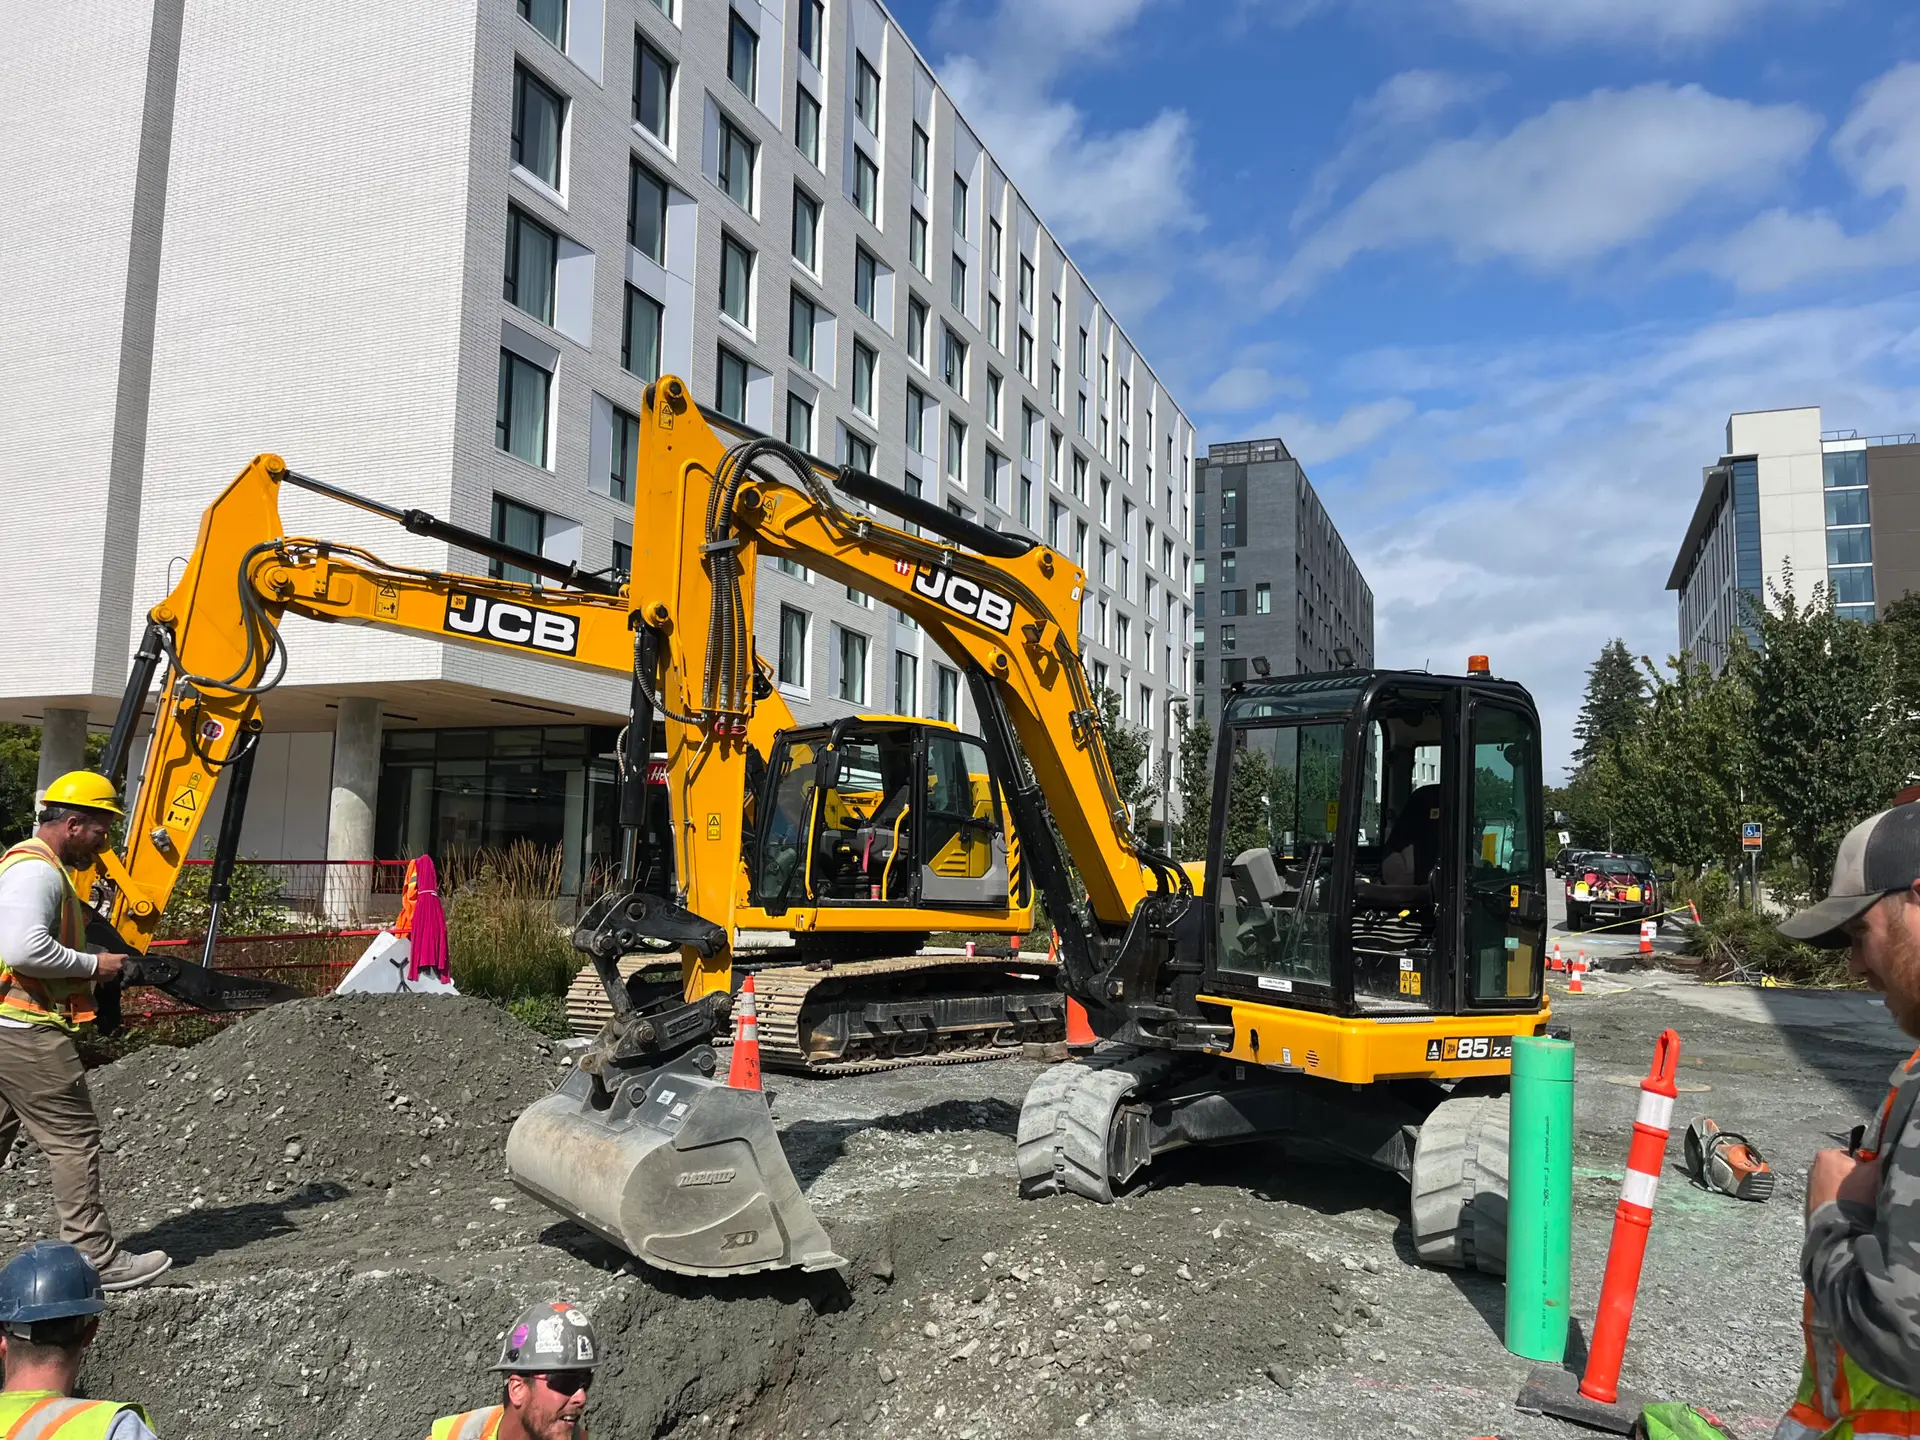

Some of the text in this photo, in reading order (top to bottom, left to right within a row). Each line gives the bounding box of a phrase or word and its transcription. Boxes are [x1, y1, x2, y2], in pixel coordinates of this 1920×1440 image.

[915, 567, 1012, 630] JCB
[448, 598, 576, 652] JCB
[1457, 1038, 1489, 1059] 85
[720, 1230, 759, 1250] XD
